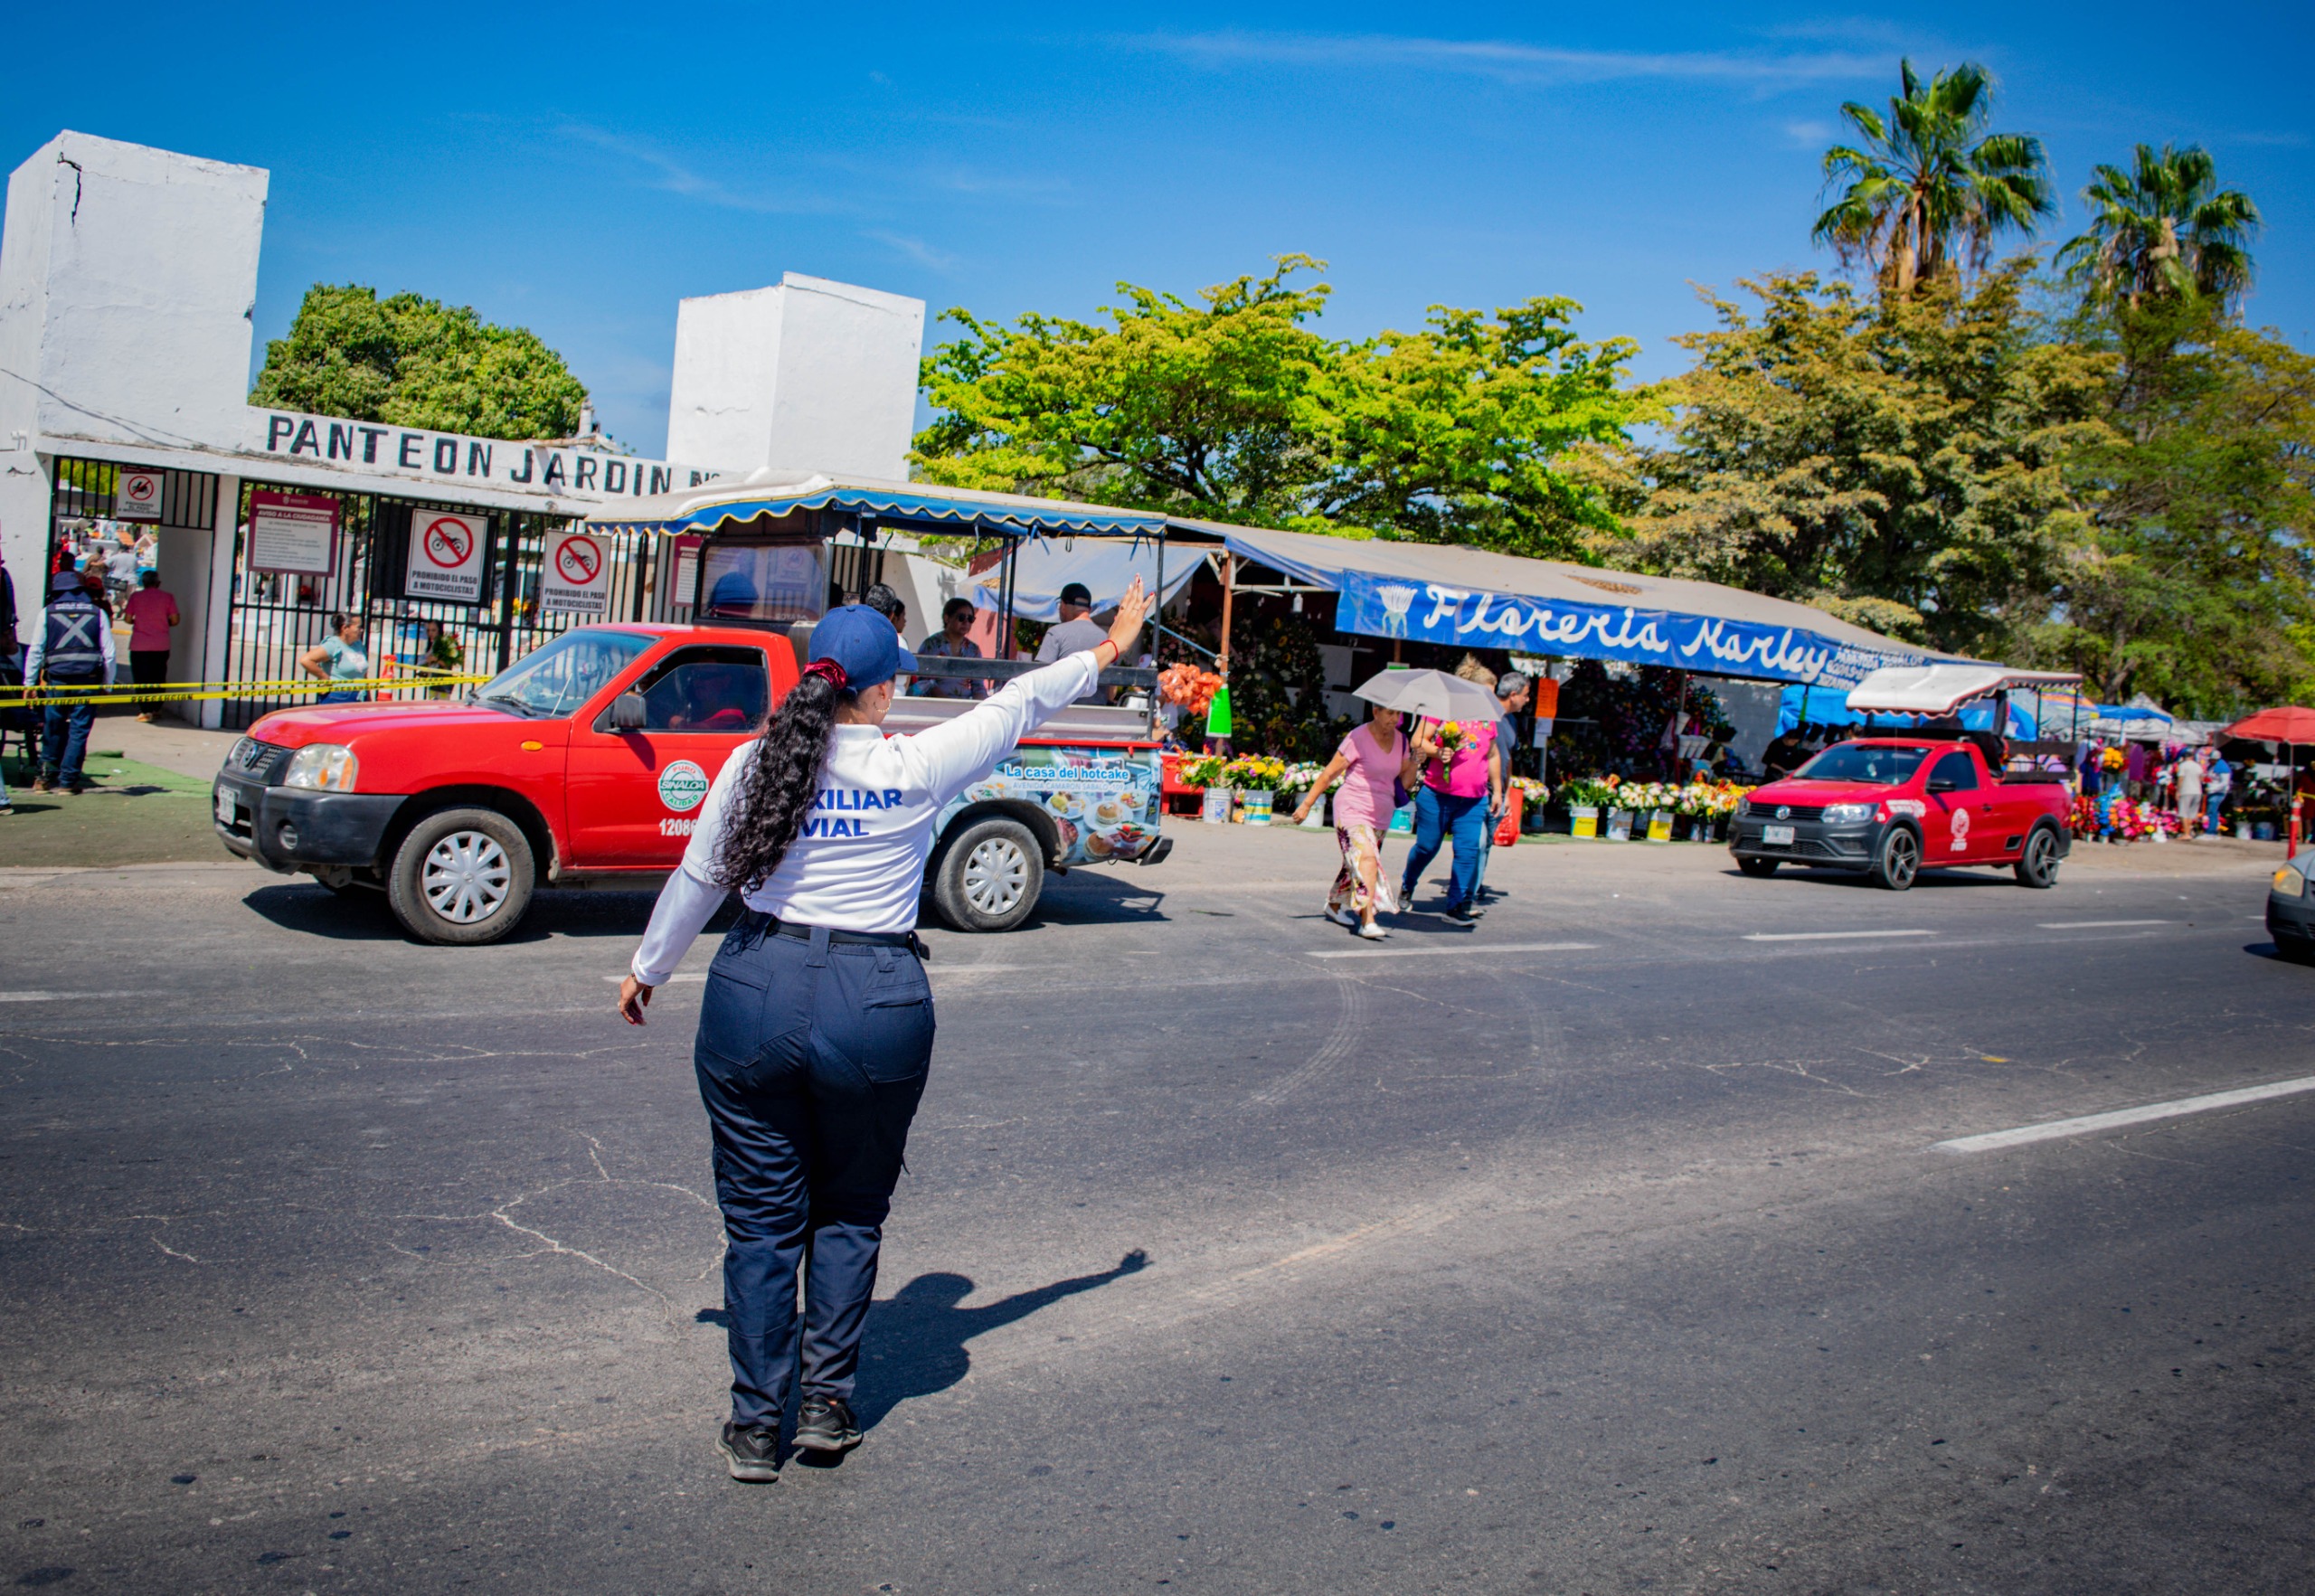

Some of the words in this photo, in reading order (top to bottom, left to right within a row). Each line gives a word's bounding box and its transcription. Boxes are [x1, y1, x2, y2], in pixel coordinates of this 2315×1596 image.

[267, 415, 492, 477] PANTEON
[510, 449, 672, 496] JARDIN
[412, 571, 450, 581] PROHIBIDO
[459, 576, 478, 584] PASO
[420, 582, 474, 594] MOTOCICLISTAS
[544, 588, 581, 598] PROHIBIDO
[590, 591, 605, 600] PASO
[552, 599, 603, 609] MOTOCICLISTAS
[1681, 619, 1828, 682] Marley
[672, 765, 696, 775] PURO
[1006, 766, 1022, 777] La
[1025, 768, 1056, 778] casa
[1059, 767, 1078, 779] del
[1081, 767, 1129, 779] hotcake
[661, 780, 705, 790] SINALOA
[1013, 781, 1044, 789] AVENIDA
[1045, 782, 1081, 790] CAMARON
[1082, 783, 1109, 791] SABALO
[665, 792, 699, 807] CALIDAD
[808, 789, 903, 810] XILIAR
[801, 817, 869, 837] VIAL
